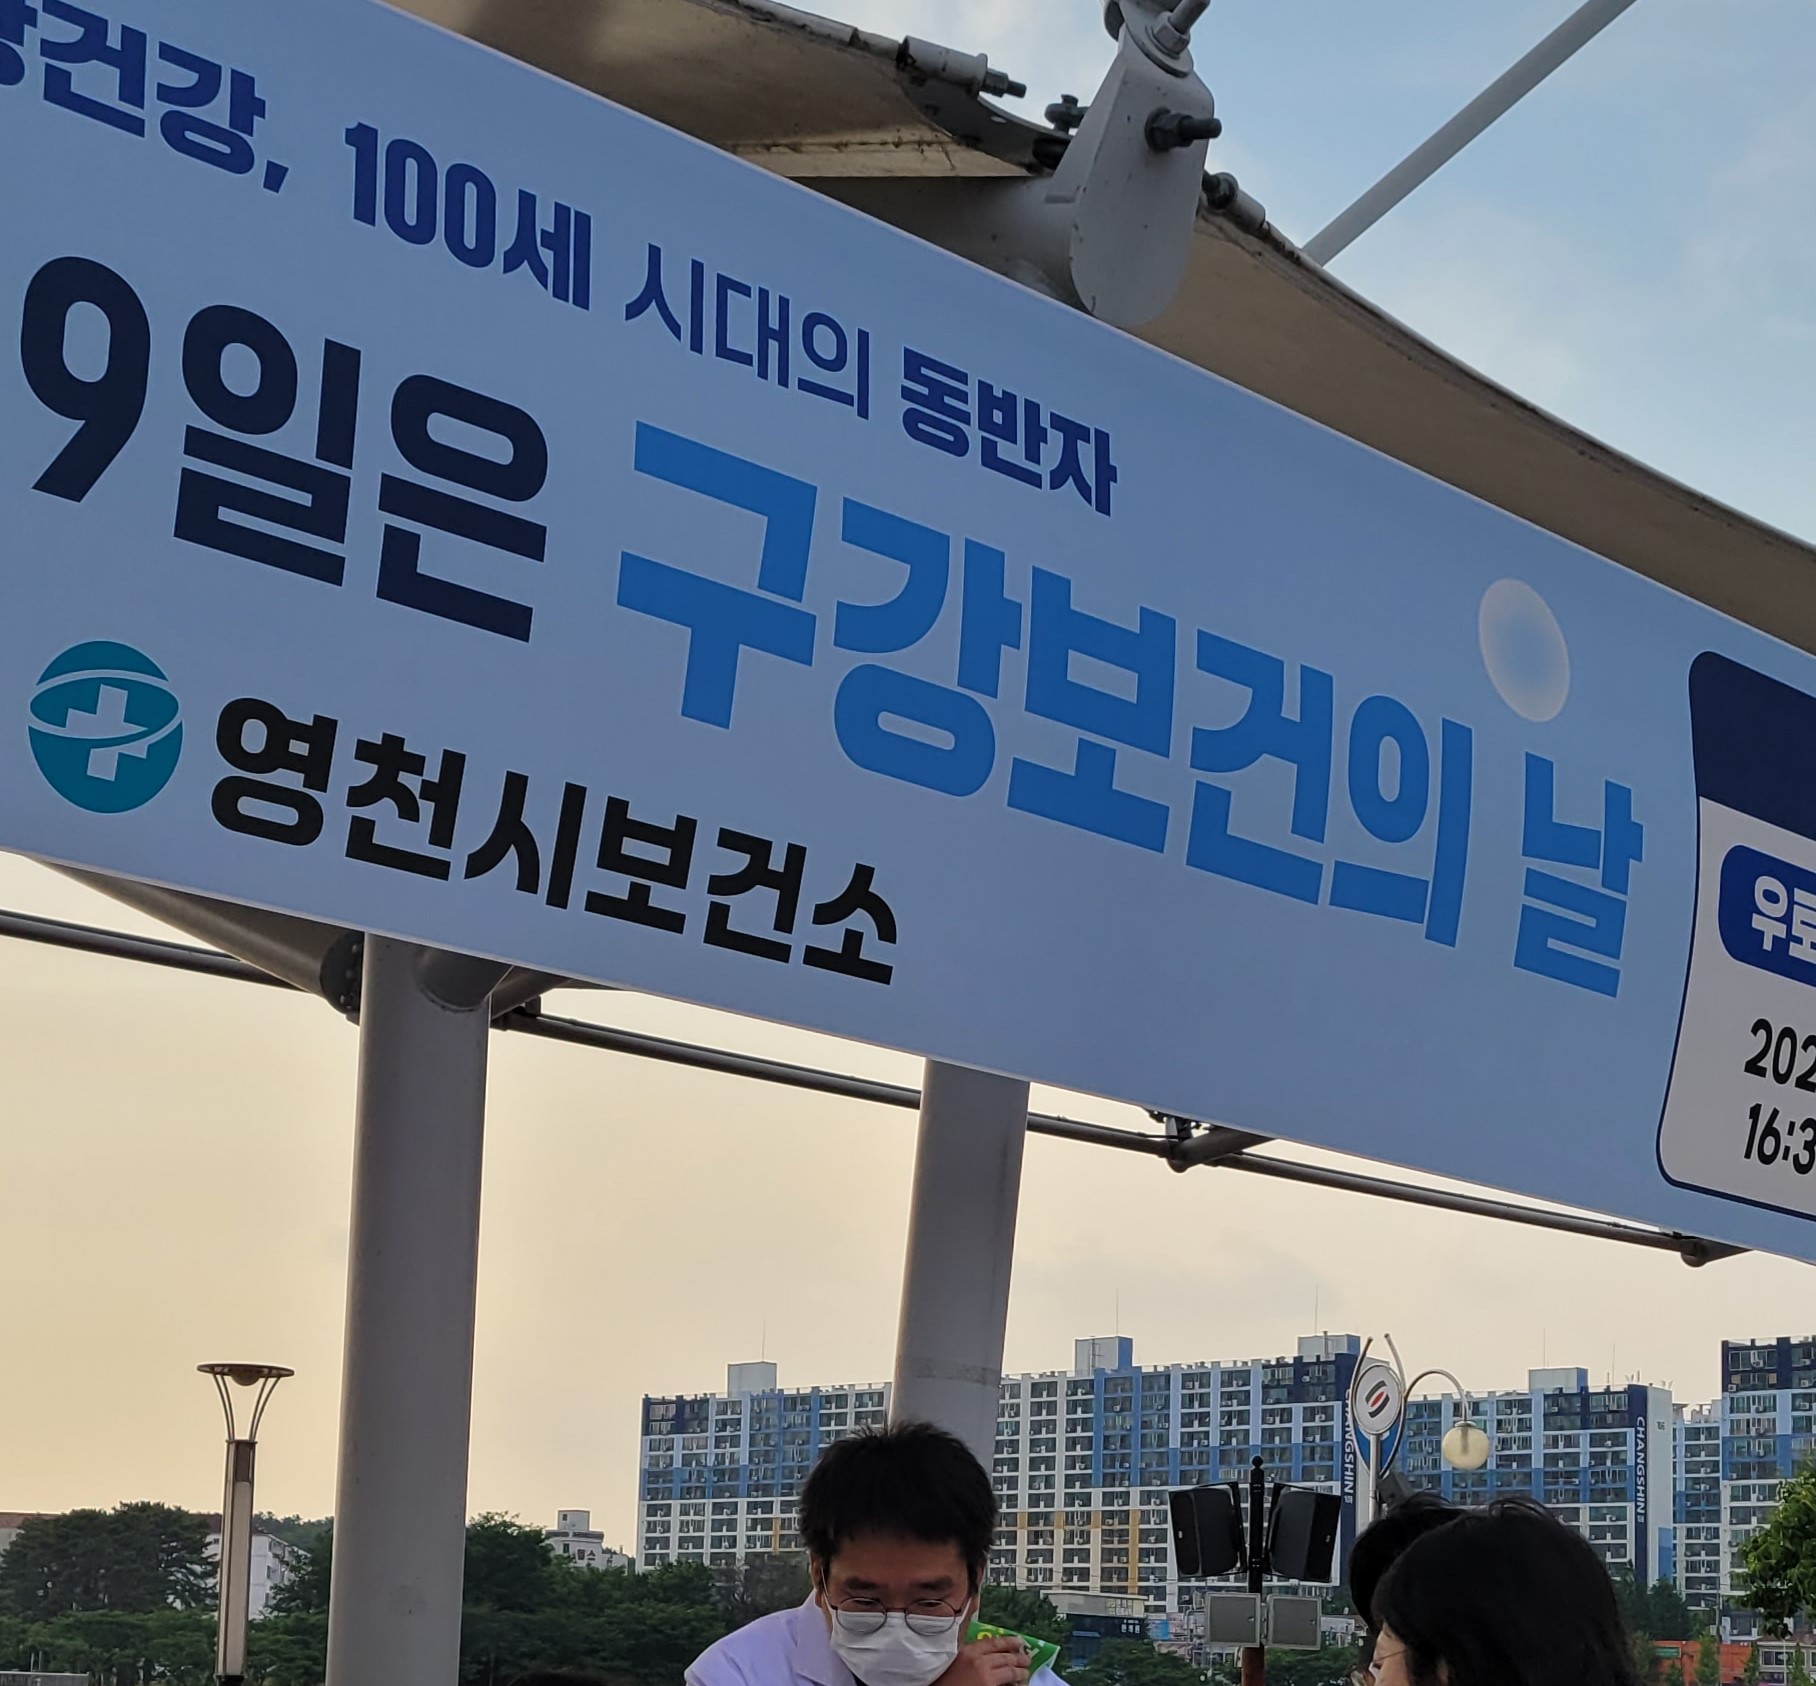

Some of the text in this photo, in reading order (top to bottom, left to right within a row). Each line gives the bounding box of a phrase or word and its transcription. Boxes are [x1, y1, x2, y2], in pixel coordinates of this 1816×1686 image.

[344, 121, 592, 311] 100세
[625, 243, 870, 420] 시대의
[901, 346, 1118, 517] 동반자
[20, 256, 1643, 998] 9일은 구강보건의 날
[211, 697, 898, 985] 영천시보건소
[1636, 1416, 1646, 1514] CHANGSHIN
